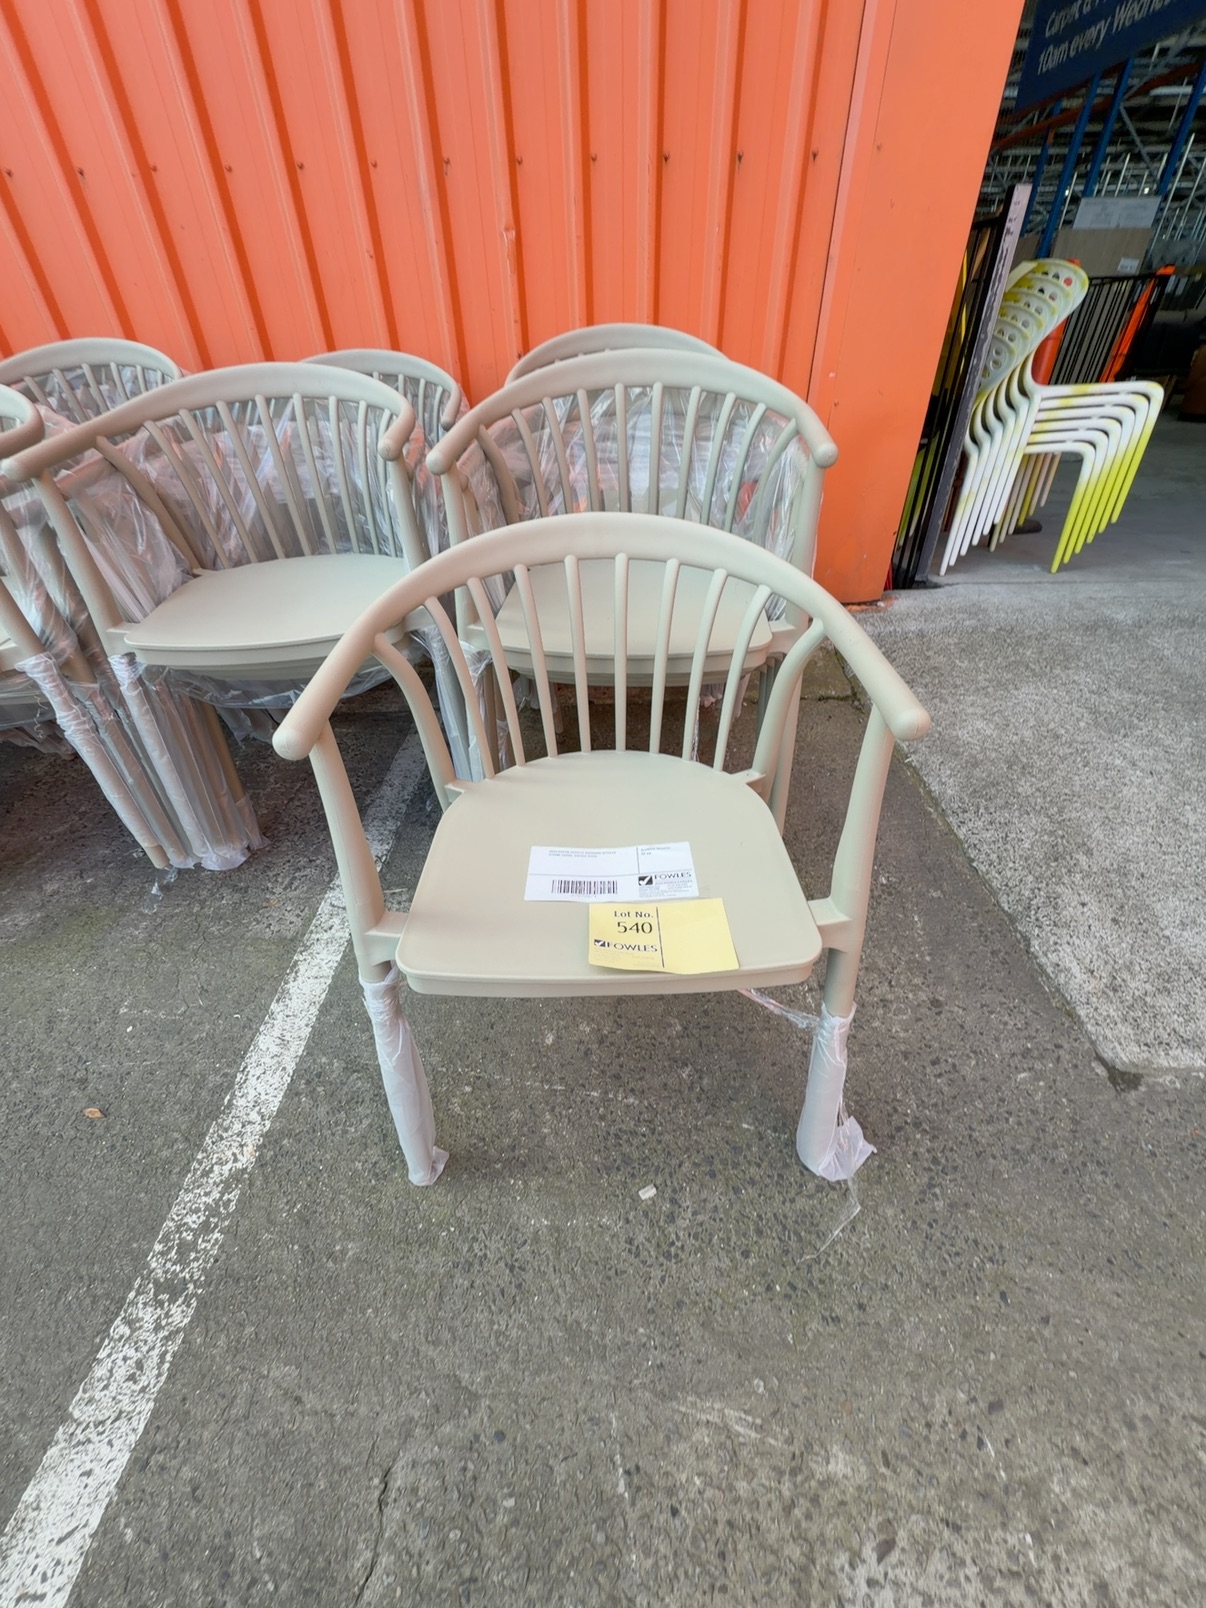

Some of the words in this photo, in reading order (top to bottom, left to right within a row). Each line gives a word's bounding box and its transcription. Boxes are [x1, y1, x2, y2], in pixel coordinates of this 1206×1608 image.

[1045, 0, 1083, 38] Carpet
[1037, 40, 1068, 76] 10am
[1069, 16, 1112, 58] every
[654, 872, 692, 880] FOWLES
[614, 910, 631, 918] Lot
[617, 921, 653, 934] 540
[607, 941, 658, 952] FOWLES
